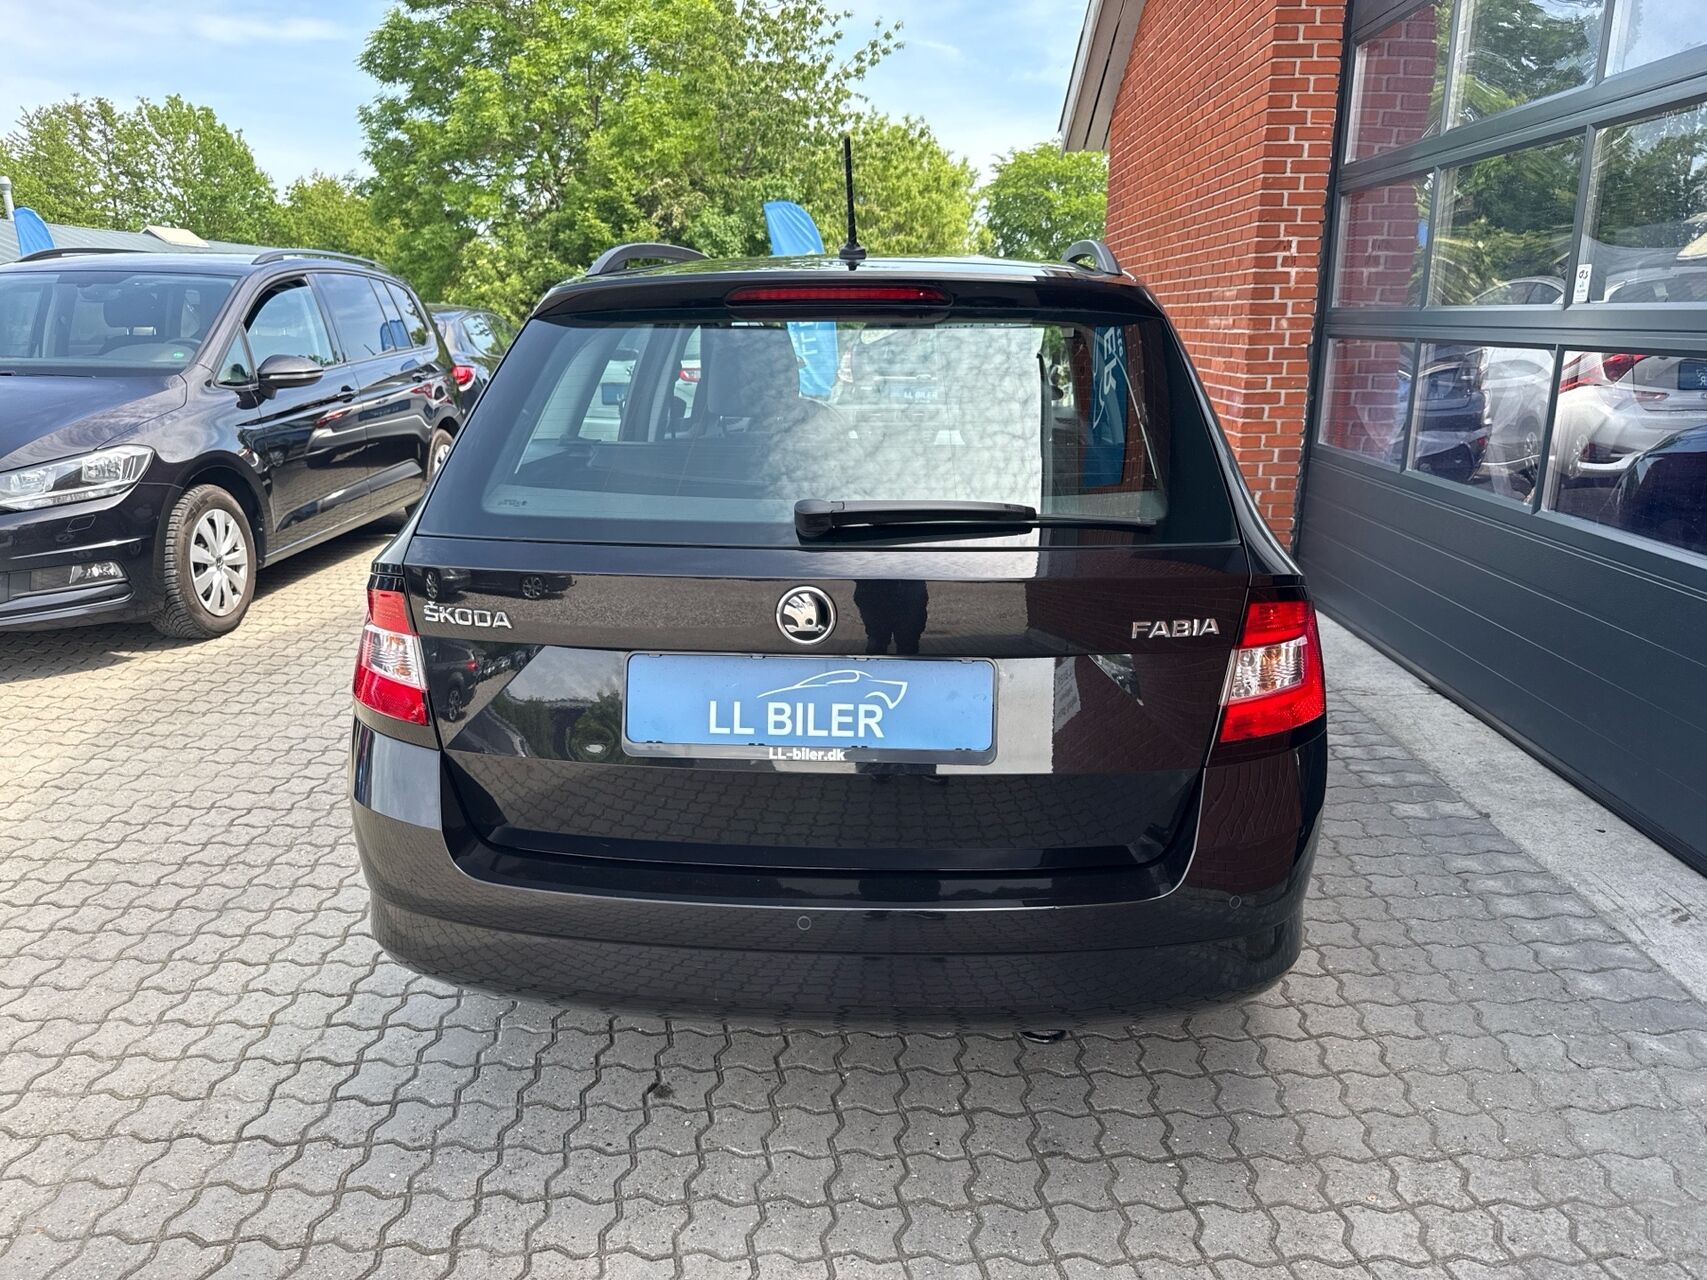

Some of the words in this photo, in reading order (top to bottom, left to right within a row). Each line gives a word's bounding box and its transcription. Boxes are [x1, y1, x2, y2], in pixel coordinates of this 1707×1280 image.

[423, 601, 512, 629] ŠKODA
[1131, 618, 1220, 639] FABIA
[709, 701, 755, 736] LL
[767, 702, 885, 739] BILER
[768, 747, 846, 762] LL-biler.dk
